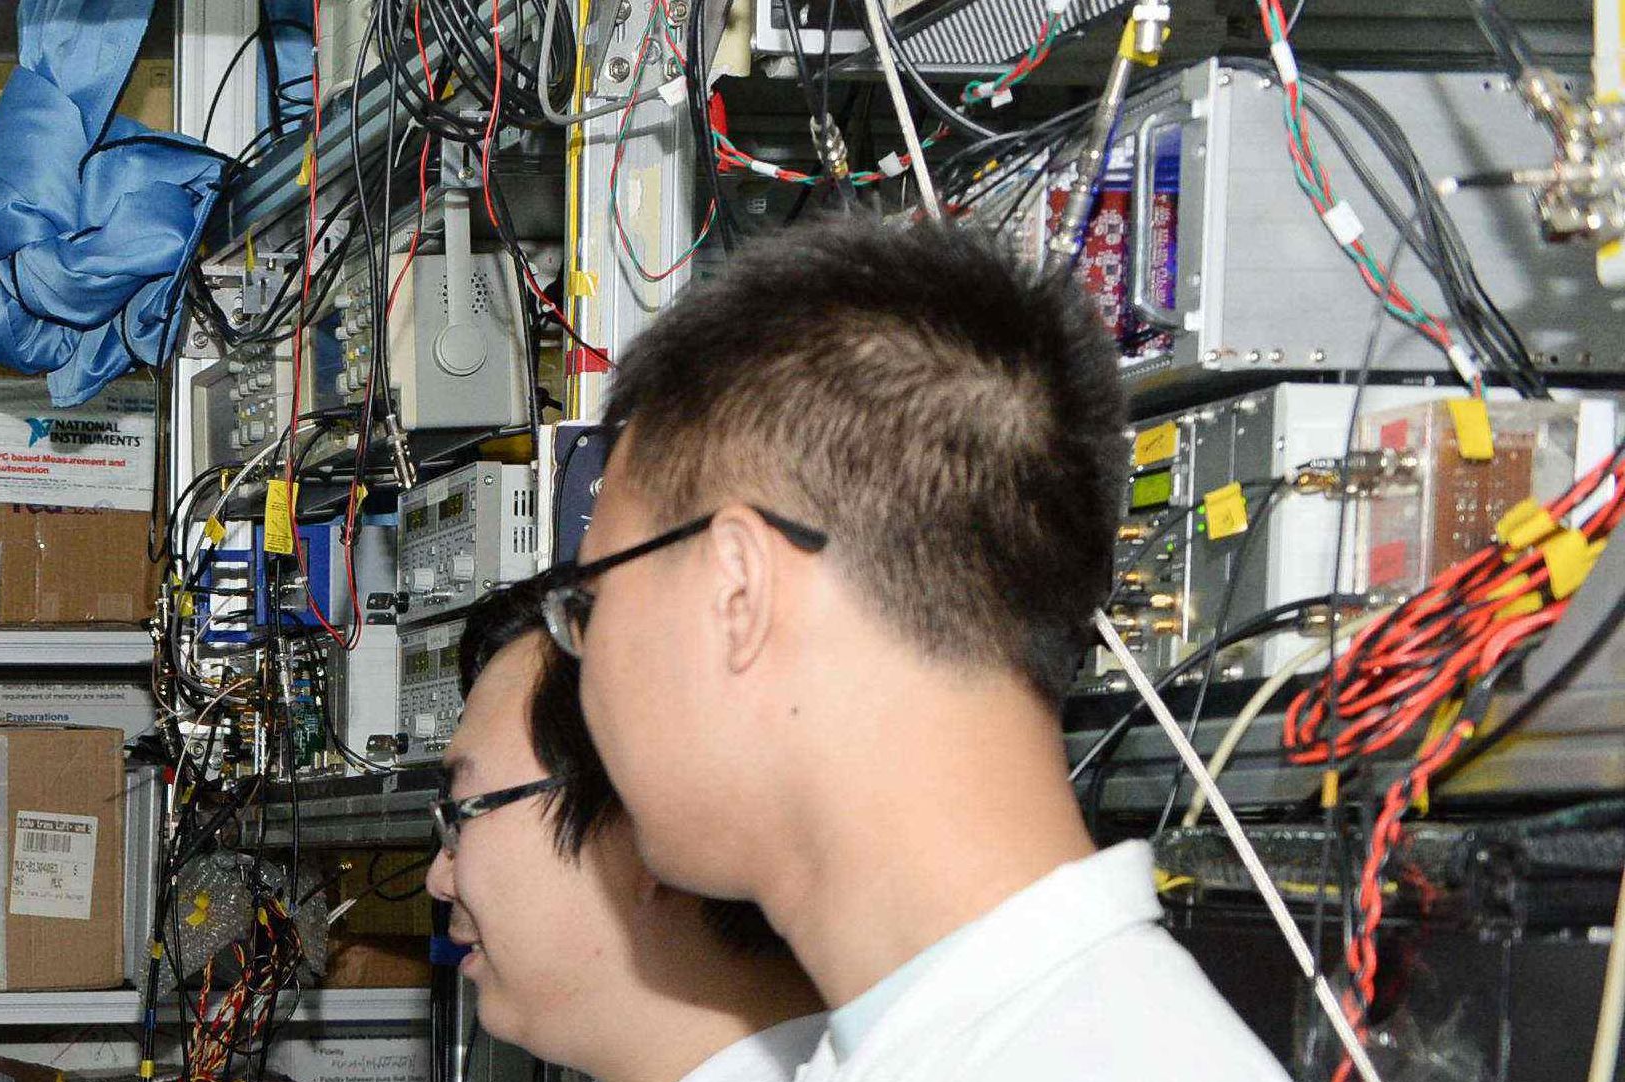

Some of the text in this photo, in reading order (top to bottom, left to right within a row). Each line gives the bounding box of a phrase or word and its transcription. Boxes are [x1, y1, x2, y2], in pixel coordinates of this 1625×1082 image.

[55, 420, 121, 433] NATIONAL
[50, 433, 142, 447] INSTRUMENTS
[11, 454, 40, 463] based
[42, 455, 106, 467] Measurement
[109, 459, 126, 467] and
[6, 712, 70, 723] Preparations
